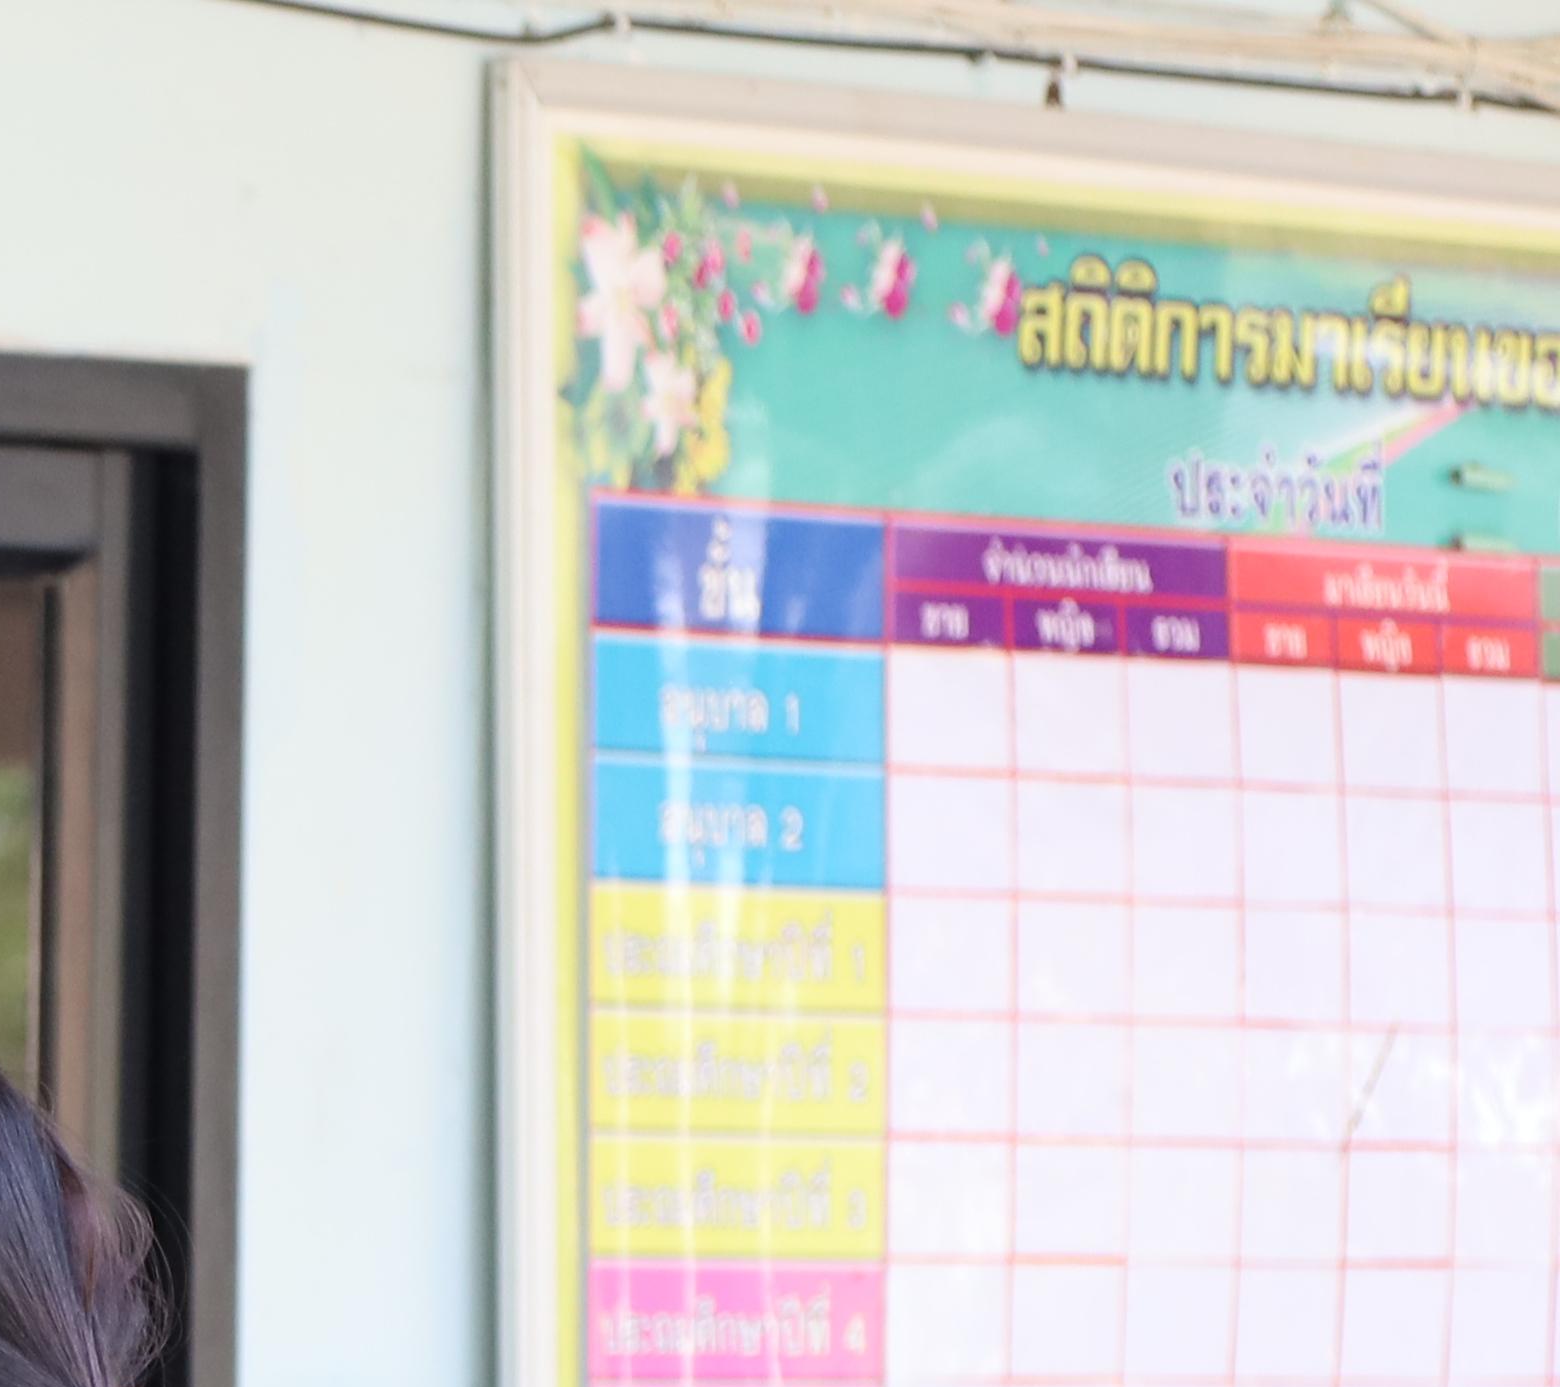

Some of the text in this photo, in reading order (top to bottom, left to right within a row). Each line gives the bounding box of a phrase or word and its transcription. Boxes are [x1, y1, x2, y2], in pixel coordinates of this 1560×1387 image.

[1172, 440, 1383, 527] ประจำวันที่
